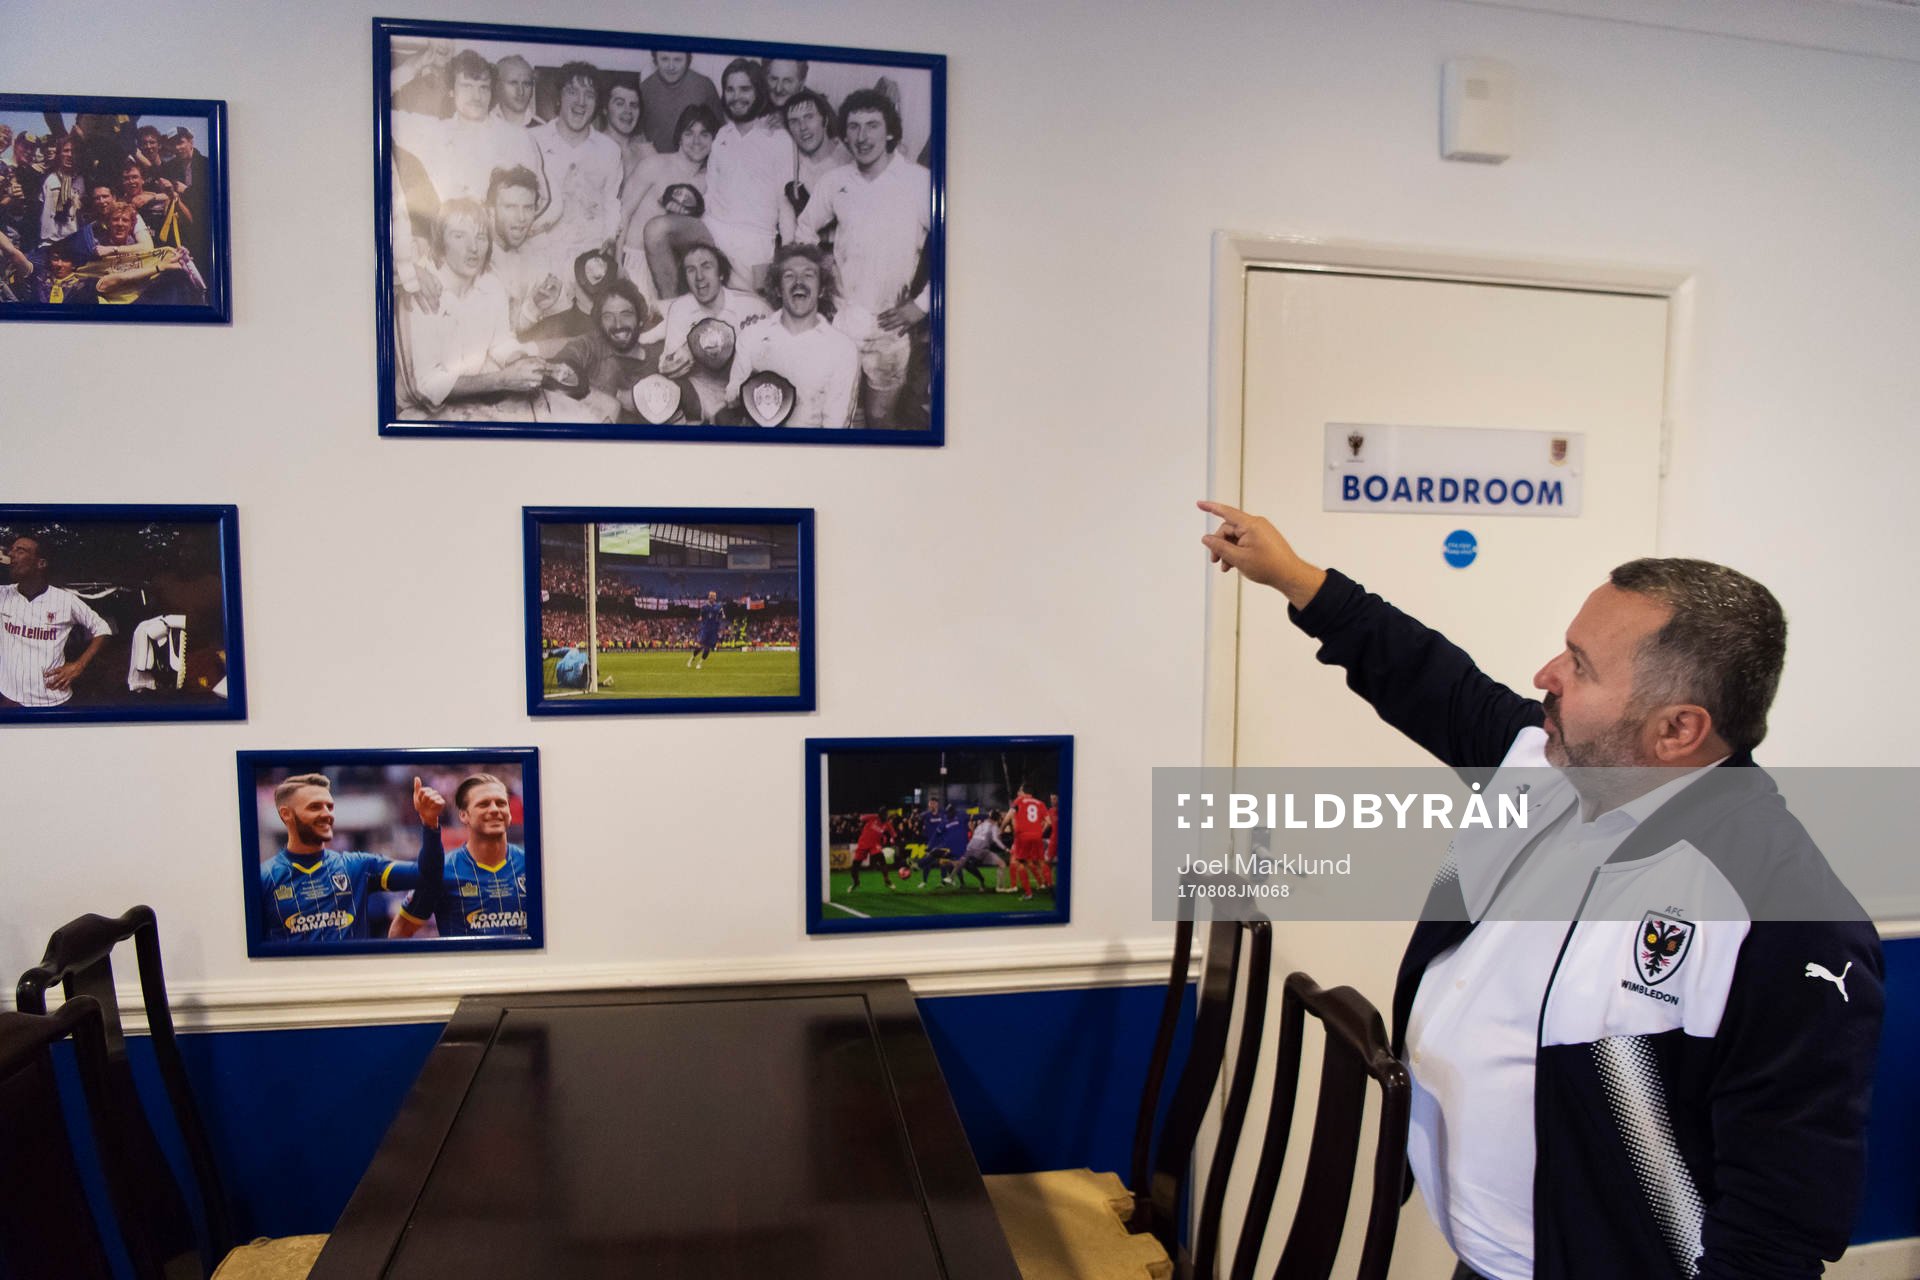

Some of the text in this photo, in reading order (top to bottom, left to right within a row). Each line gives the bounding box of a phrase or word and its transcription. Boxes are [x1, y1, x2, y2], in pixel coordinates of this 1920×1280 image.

[1342, 475, 1564, 506] BOARDROOM
[1026, 804, 1039, 822] 8
[290, 909, 347, 926] FOOTBALL
[1664, 905, 1684, 917] AFC
[290, 917, 349, 934] MANAGER
[1621, 979, 1679, 1005] WIMBLEDON
